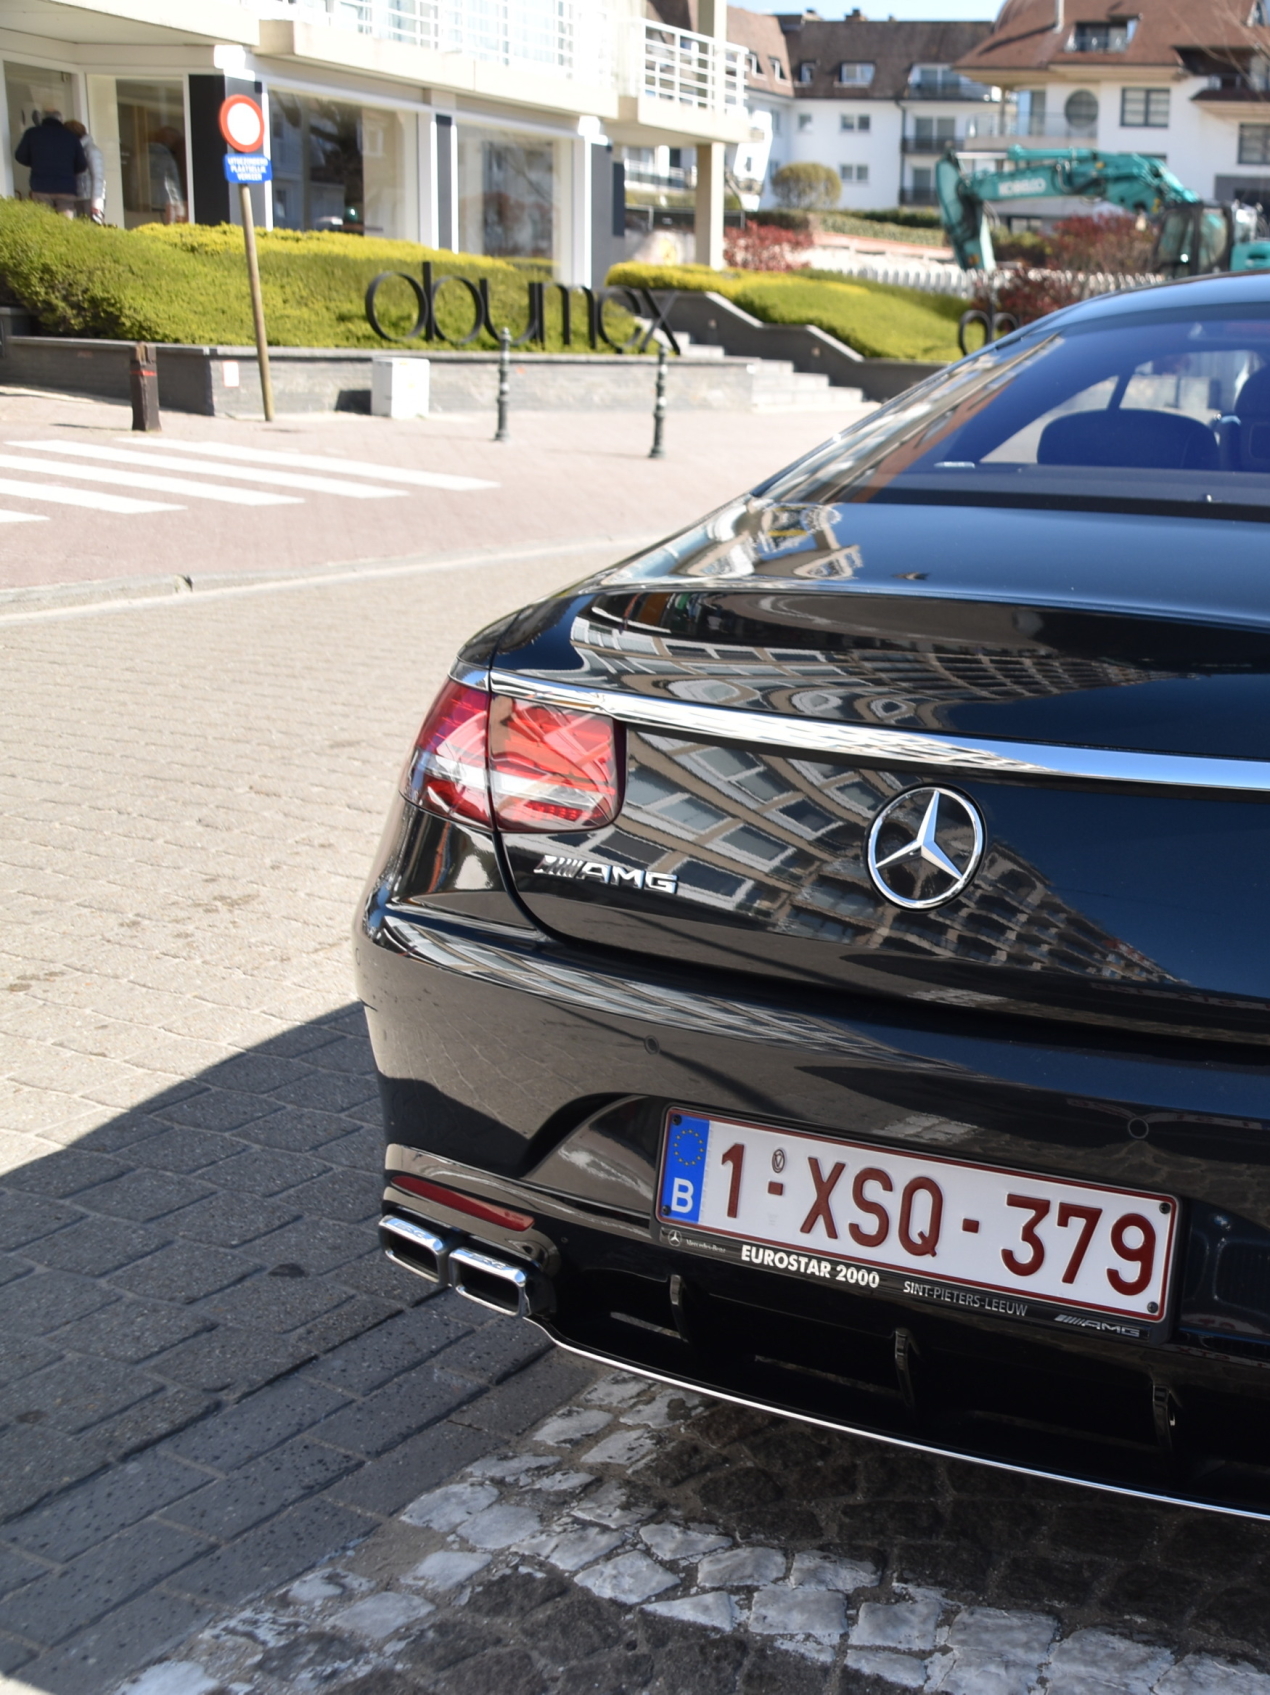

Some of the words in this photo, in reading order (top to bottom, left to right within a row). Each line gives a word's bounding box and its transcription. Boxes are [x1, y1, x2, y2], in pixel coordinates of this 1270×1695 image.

[365, 261, 681, 355] obumex
[581, 861, 679, 894] AMG
[670, 1177, 694, 1213] B
[741, 1245, 831, 1278] EUROSTAR
[835, 1263, 880, 1288] 2000
[903, 1280, 1028, 1317] SINT-PIETERS-LEEUW
